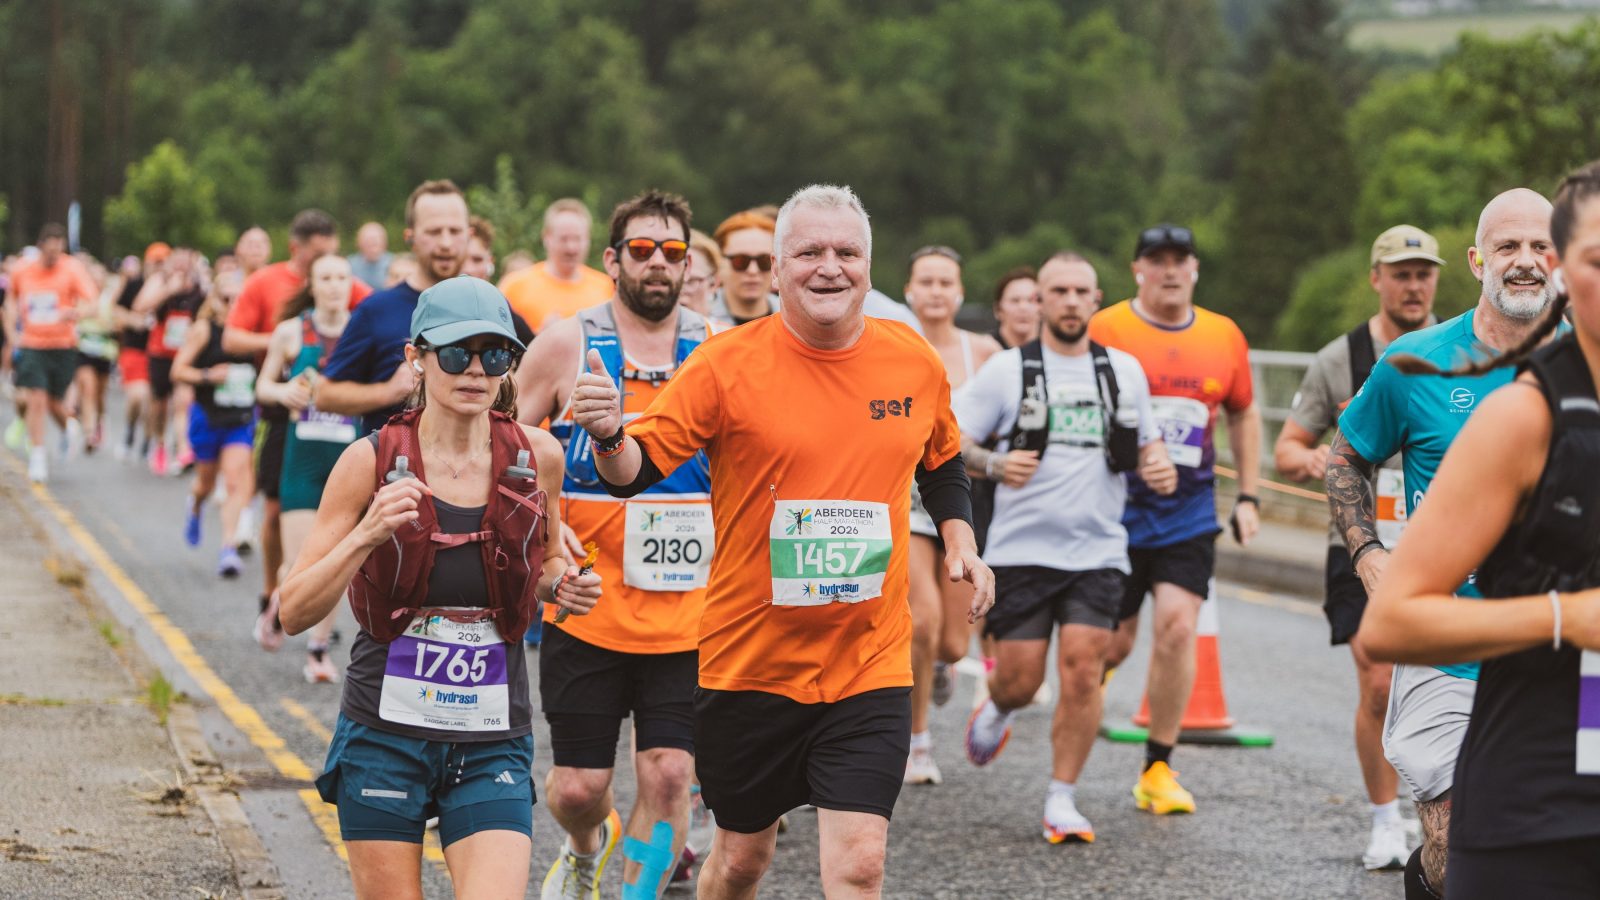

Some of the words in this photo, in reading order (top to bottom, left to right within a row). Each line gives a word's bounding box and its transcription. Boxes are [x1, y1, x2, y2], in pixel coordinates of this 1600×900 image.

[869, 396, 913, 420] gef
[664, 510, 705, 519] ABERDEEN
[814, 508, 873, 518] ABERDEEN
[675, 524, 696, 533] 2026
[830, 525, 859, 535] 2026
[642, 538, 702, 564] 2130
[794, 542, 867, 575] 1457
[819, 583, 859, 595] hydrasun
[441, 622, 460, 630] HALF
[414, 642, 489, 683] 1765
[424, 718, 449, 726] BAGGAGE
[483, 718, 501, 726] 1765
